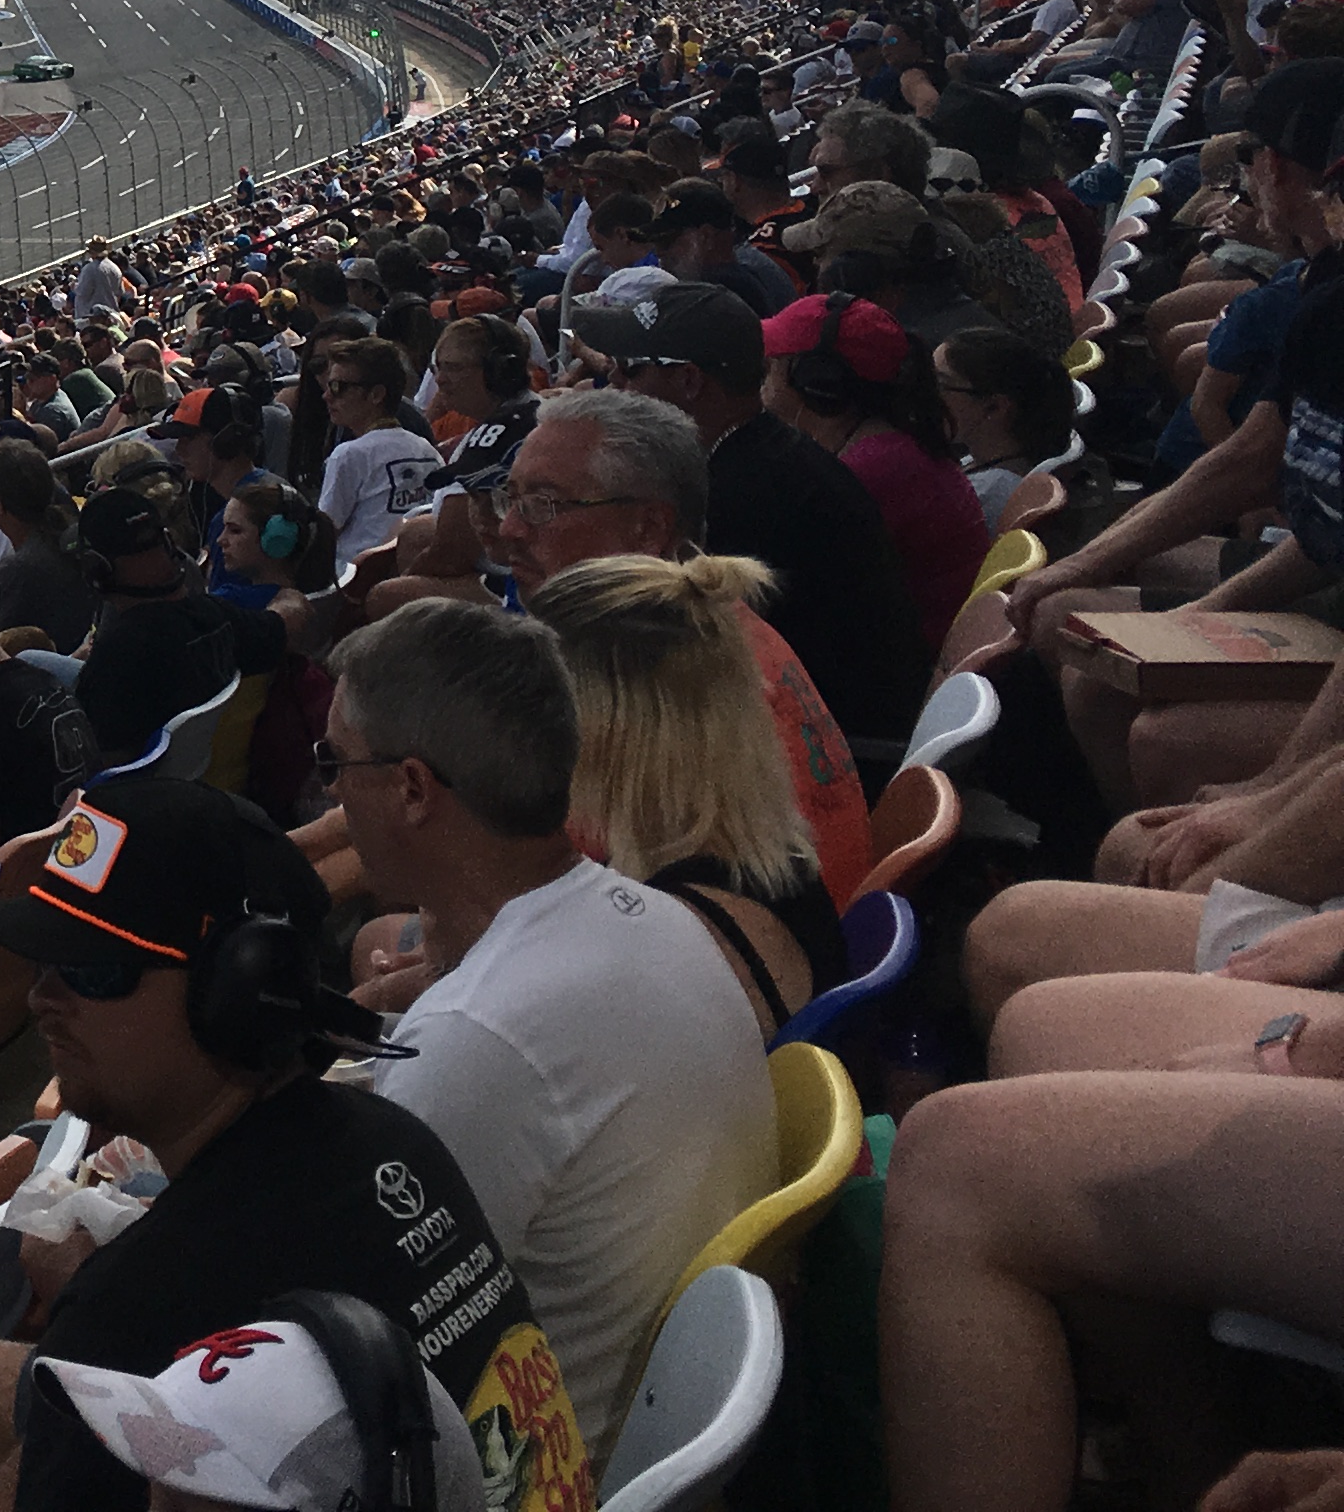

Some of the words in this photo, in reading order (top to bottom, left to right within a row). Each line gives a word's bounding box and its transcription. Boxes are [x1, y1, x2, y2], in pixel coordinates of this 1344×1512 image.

[468, 424, 507, 448] 48
[397, 1206, 457, 1261] TOYOTA
[410, 1242, 496, 1327] BASSPRO.COM
